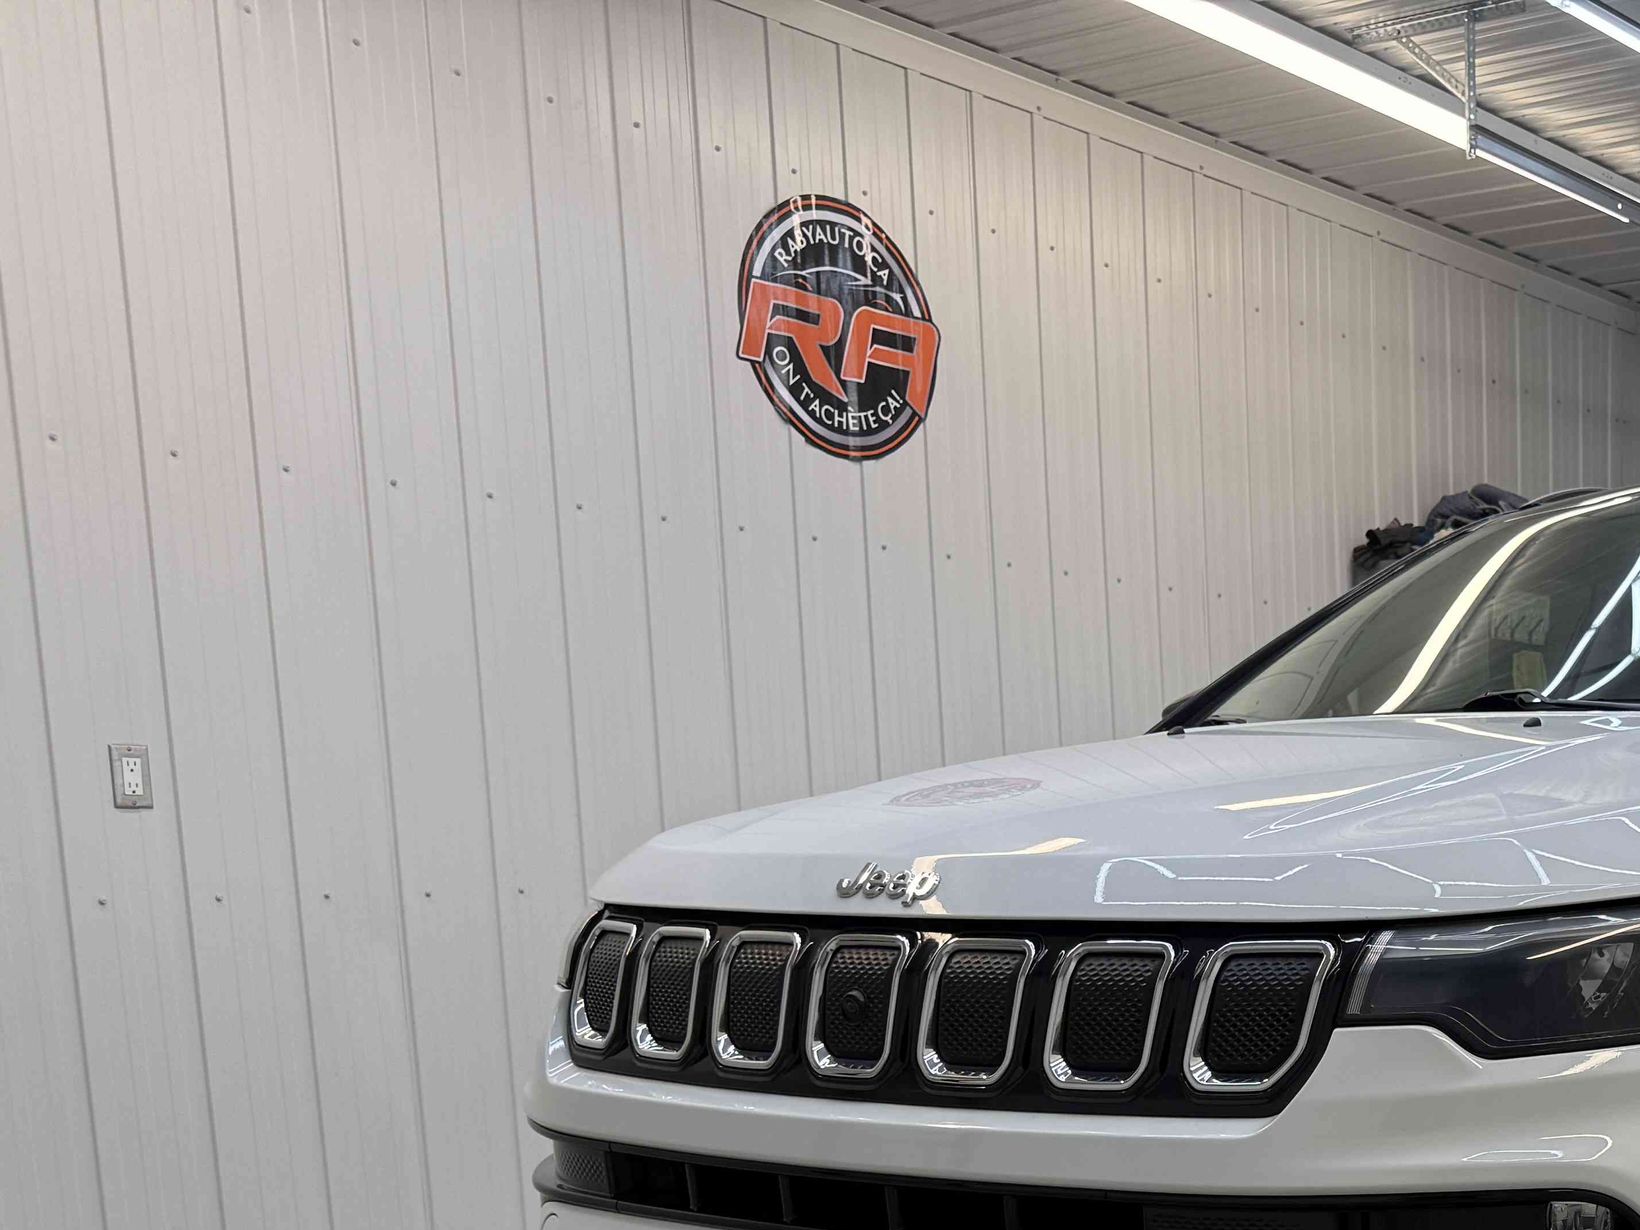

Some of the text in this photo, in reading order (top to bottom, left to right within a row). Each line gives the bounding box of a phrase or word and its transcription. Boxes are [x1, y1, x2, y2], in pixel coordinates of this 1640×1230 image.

[739, 278, 939, 421] RA
[773, 346, 903, 430] ON T'ACHÈTE ÇA!
[836, 862, 941, 907] Jeep
